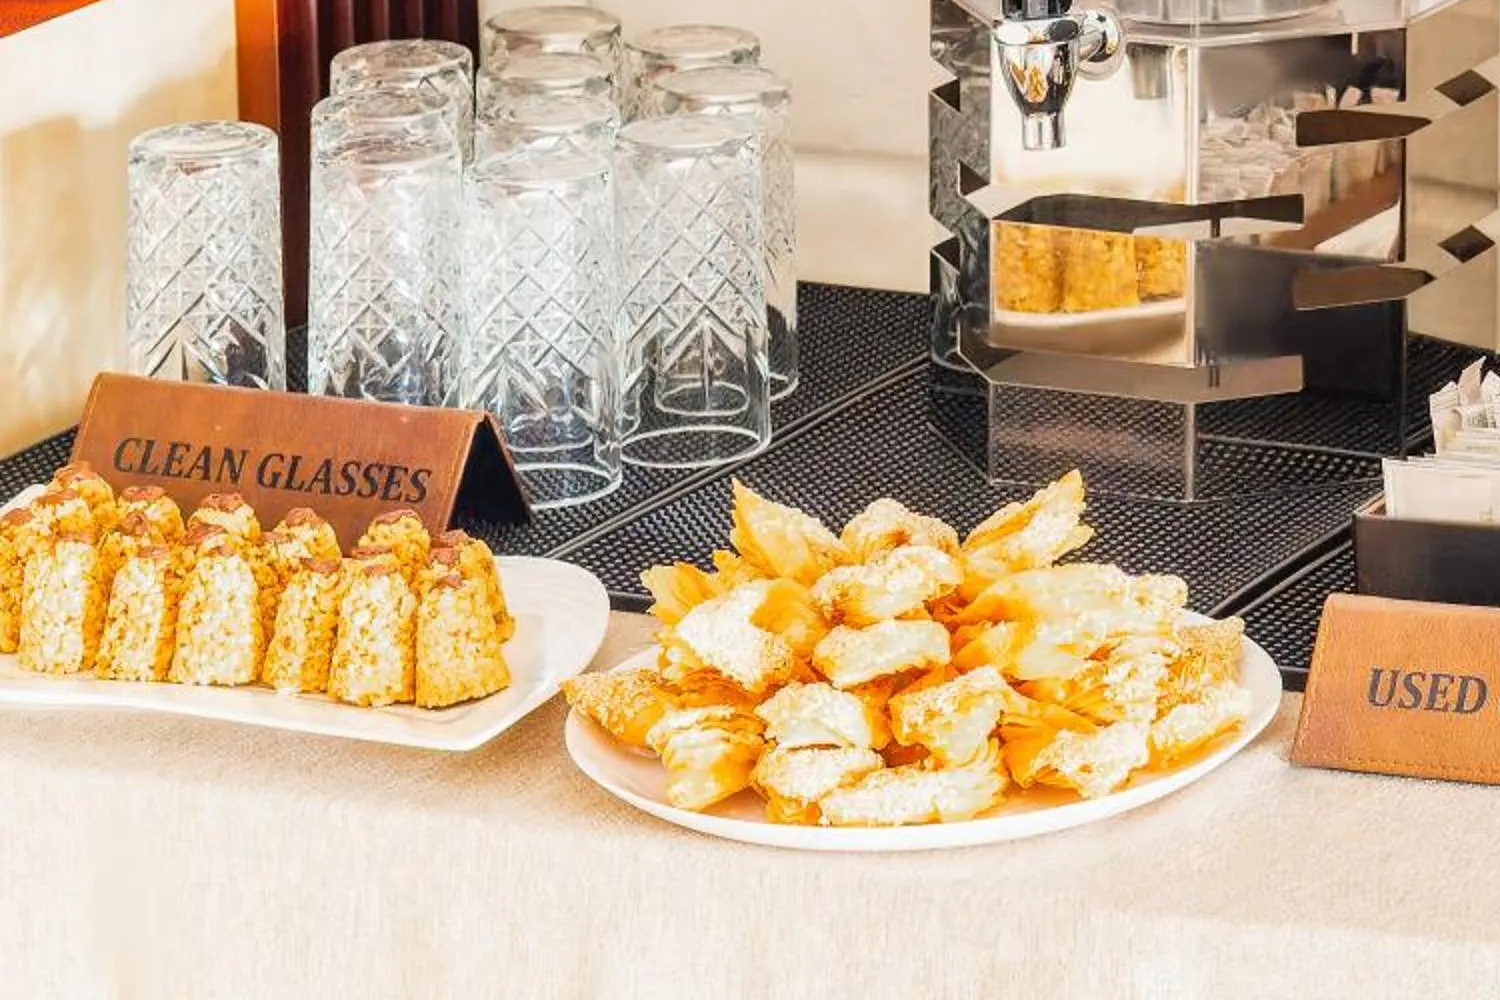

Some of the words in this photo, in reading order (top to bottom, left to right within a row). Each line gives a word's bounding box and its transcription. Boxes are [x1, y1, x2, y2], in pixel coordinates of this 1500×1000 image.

[113, 437, 249, 485] CLEAN
[256, 452, 433, 505] GLASSES
[1368, 667, 1488, 714] USED
